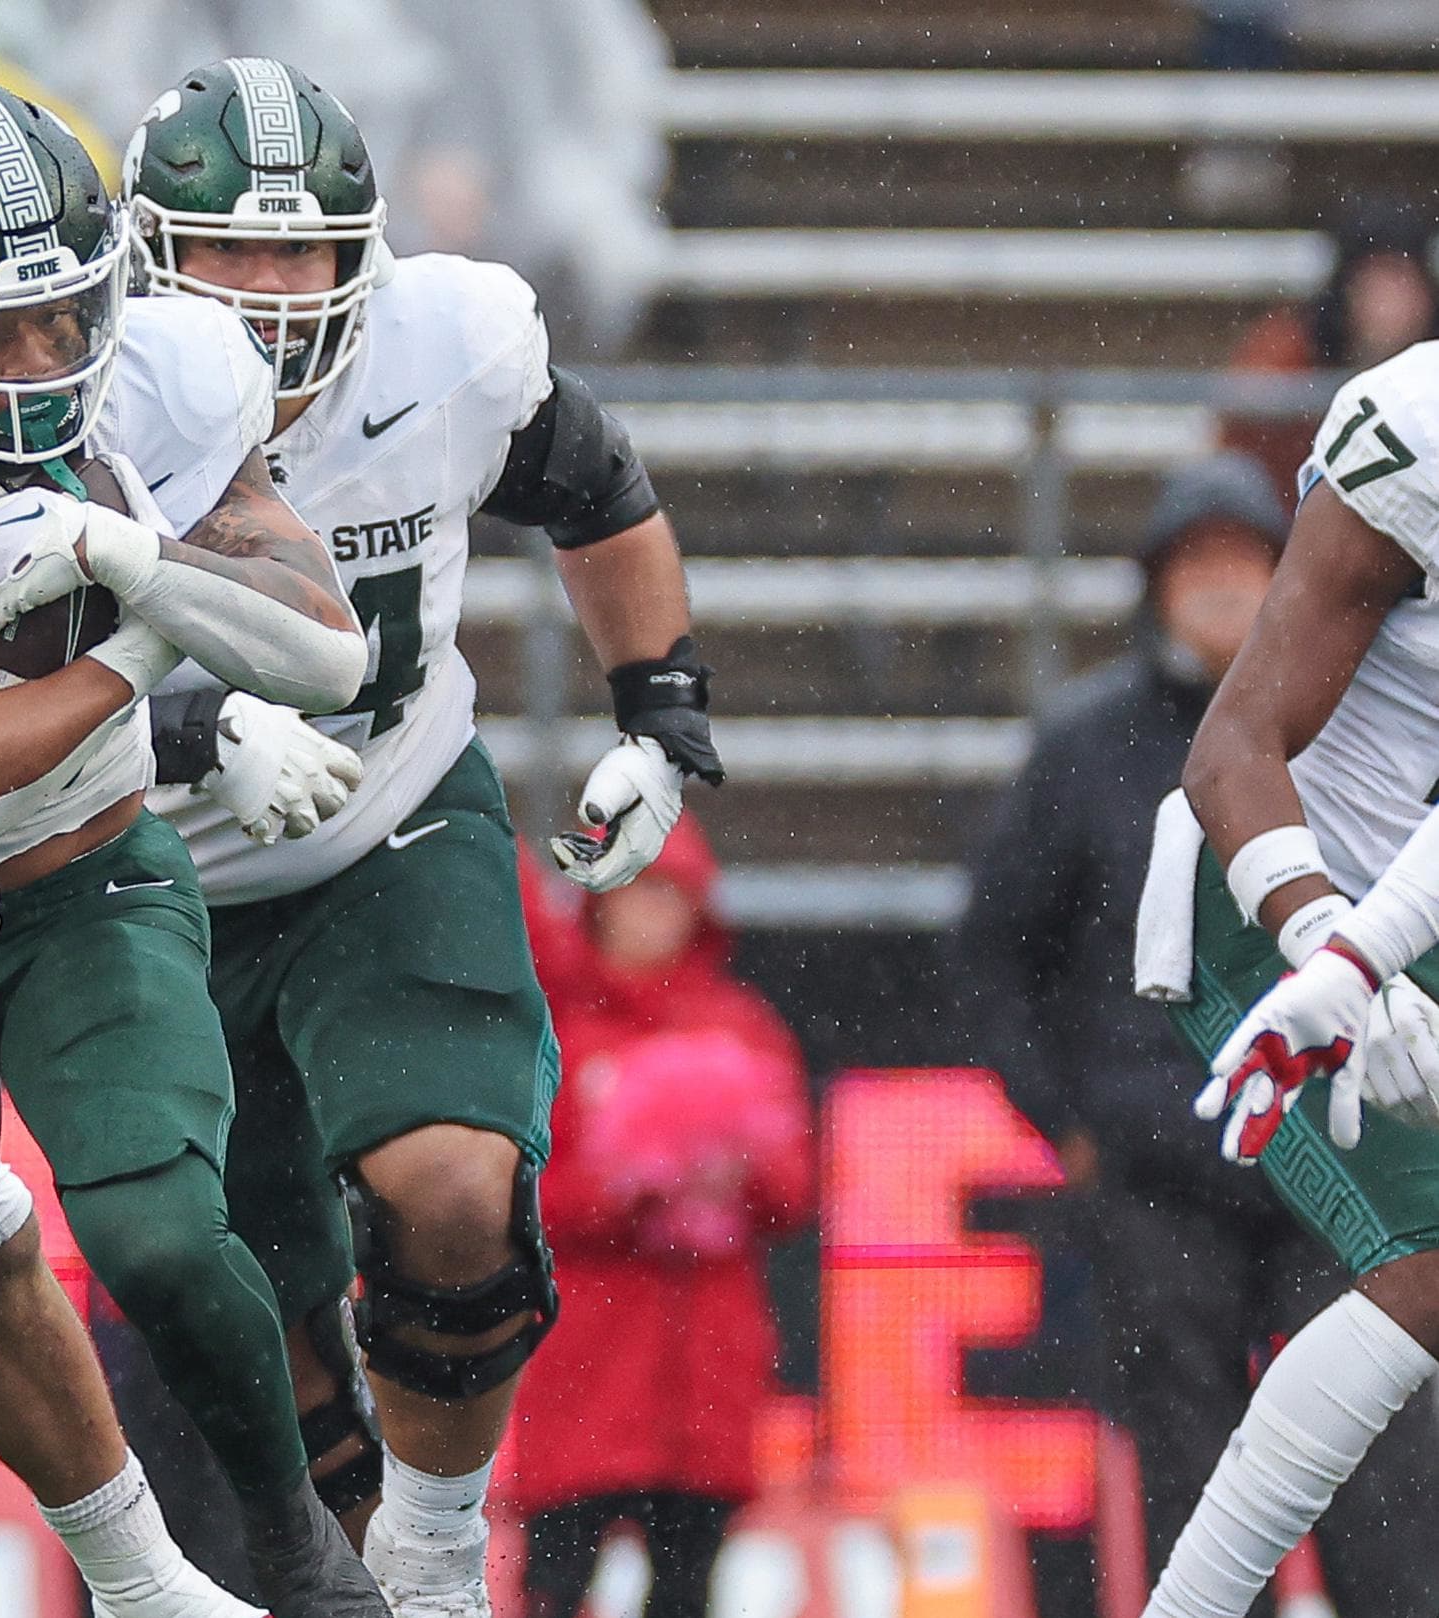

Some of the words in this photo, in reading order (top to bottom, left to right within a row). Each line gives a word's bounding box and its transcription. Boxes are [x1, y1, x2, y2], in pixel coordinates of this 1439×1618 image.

[258, 197, 302, 213] STATE
[17, 256, 61, 282] STATE
[1324, 395, 1418, 493] 17
[332, 503, 437, 562] STATE
